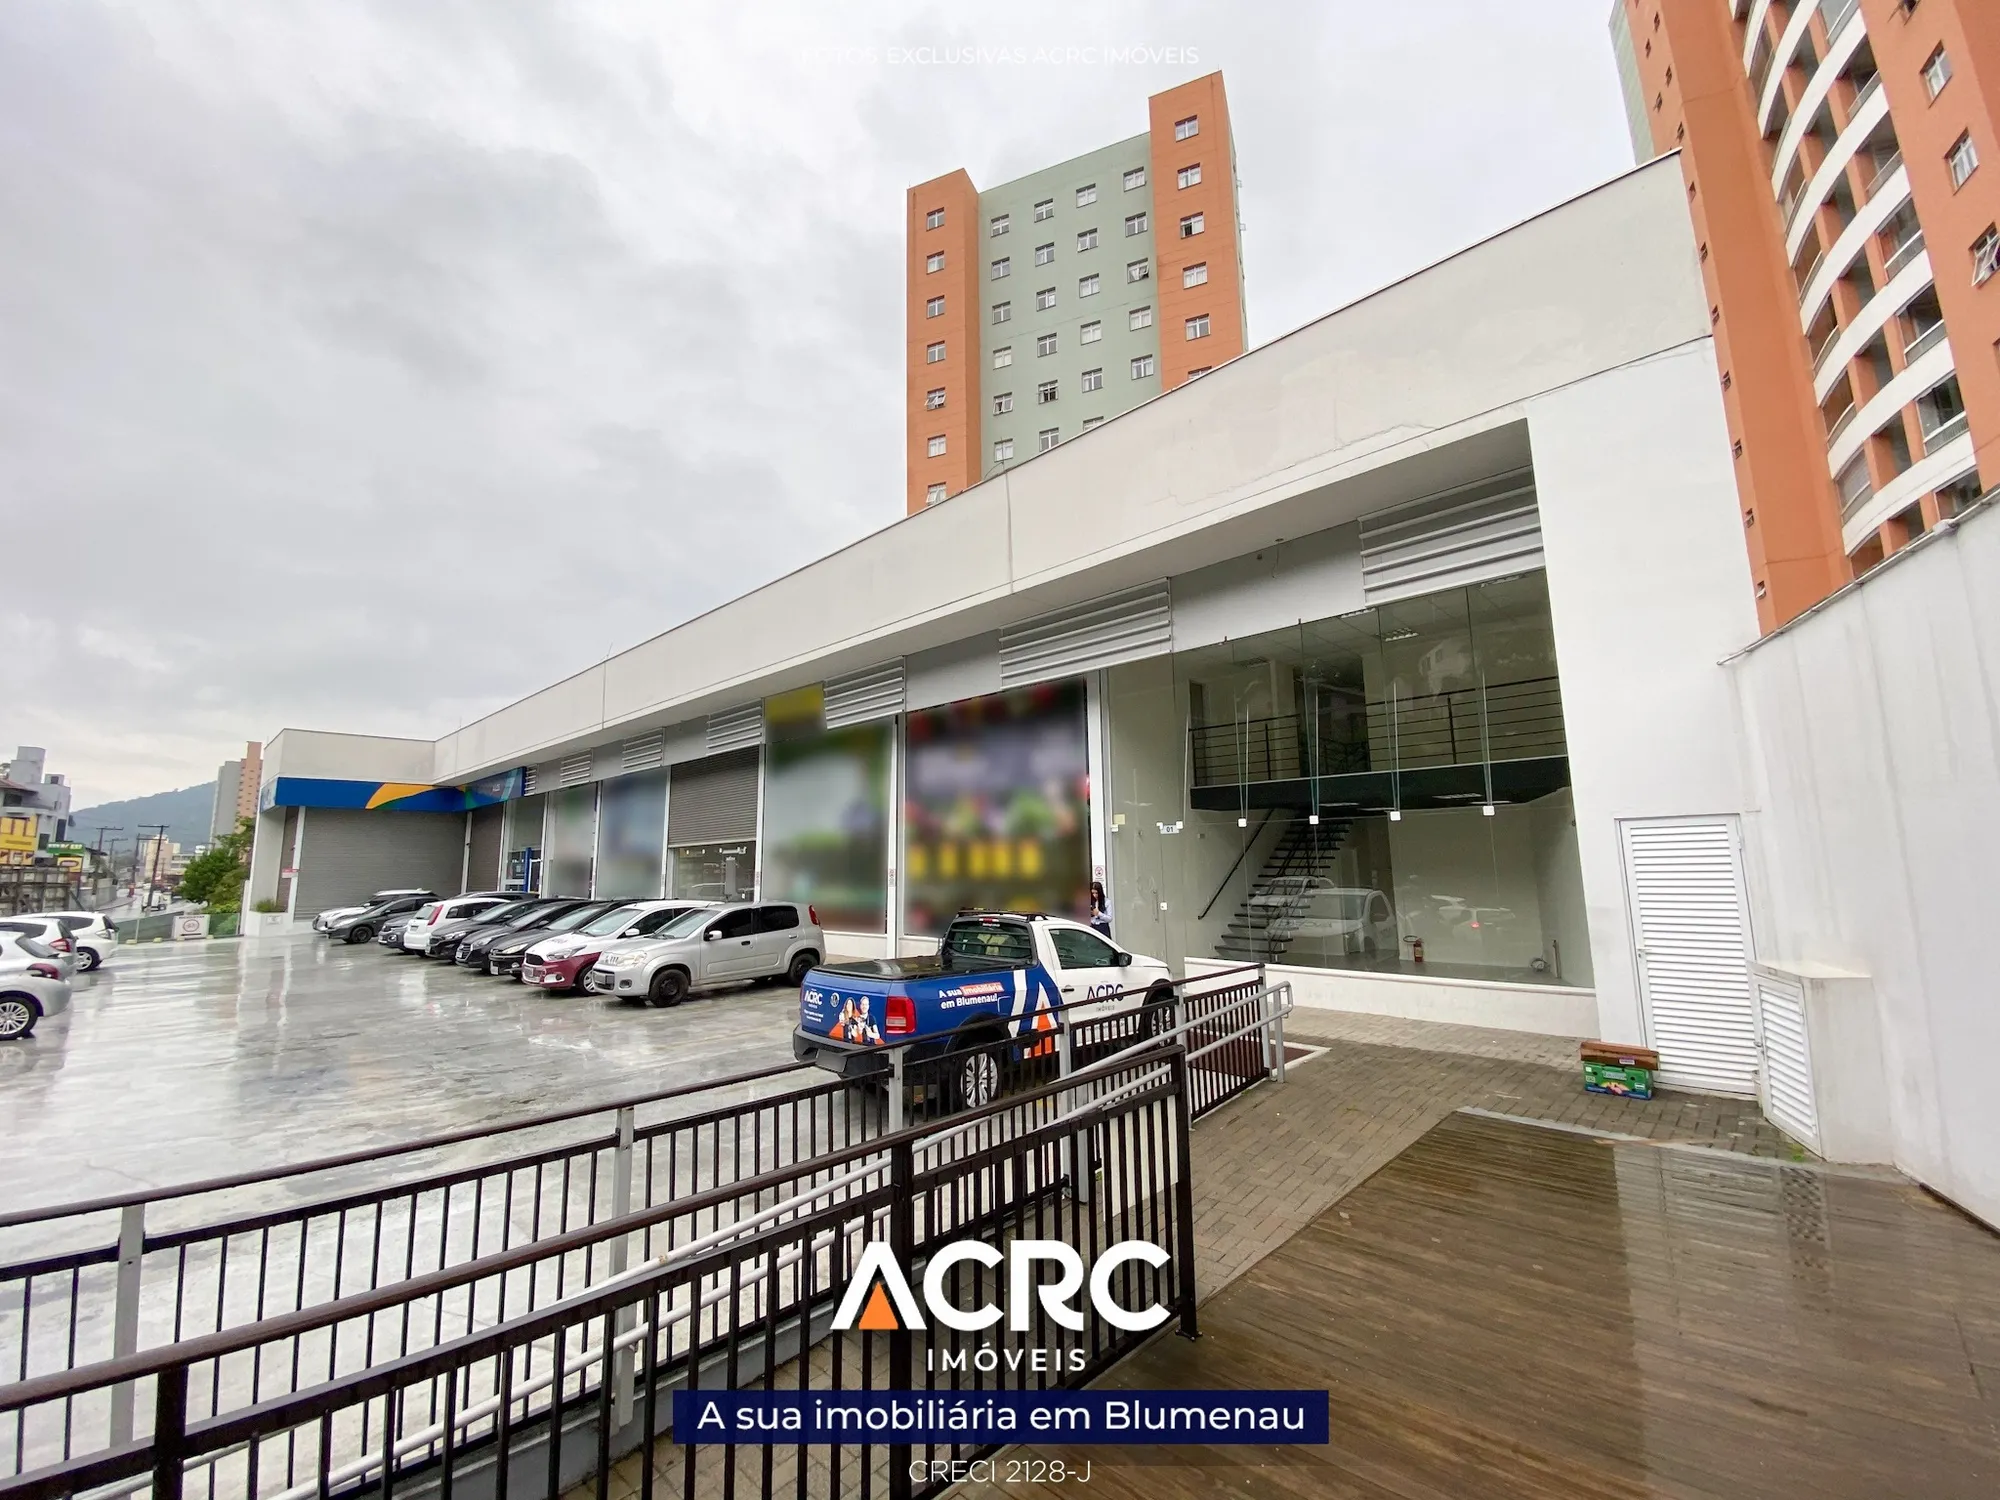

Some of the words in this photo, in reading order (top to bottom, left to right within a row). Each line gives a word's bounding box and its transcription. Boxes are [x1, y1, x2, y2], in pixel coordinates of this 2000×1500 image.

[939, 989, 947, 998] A
[946, 988, 962, 997] sua
[940, 1000, 955, 1009] em
[956, 994, 998, 1007] Blumenau!
